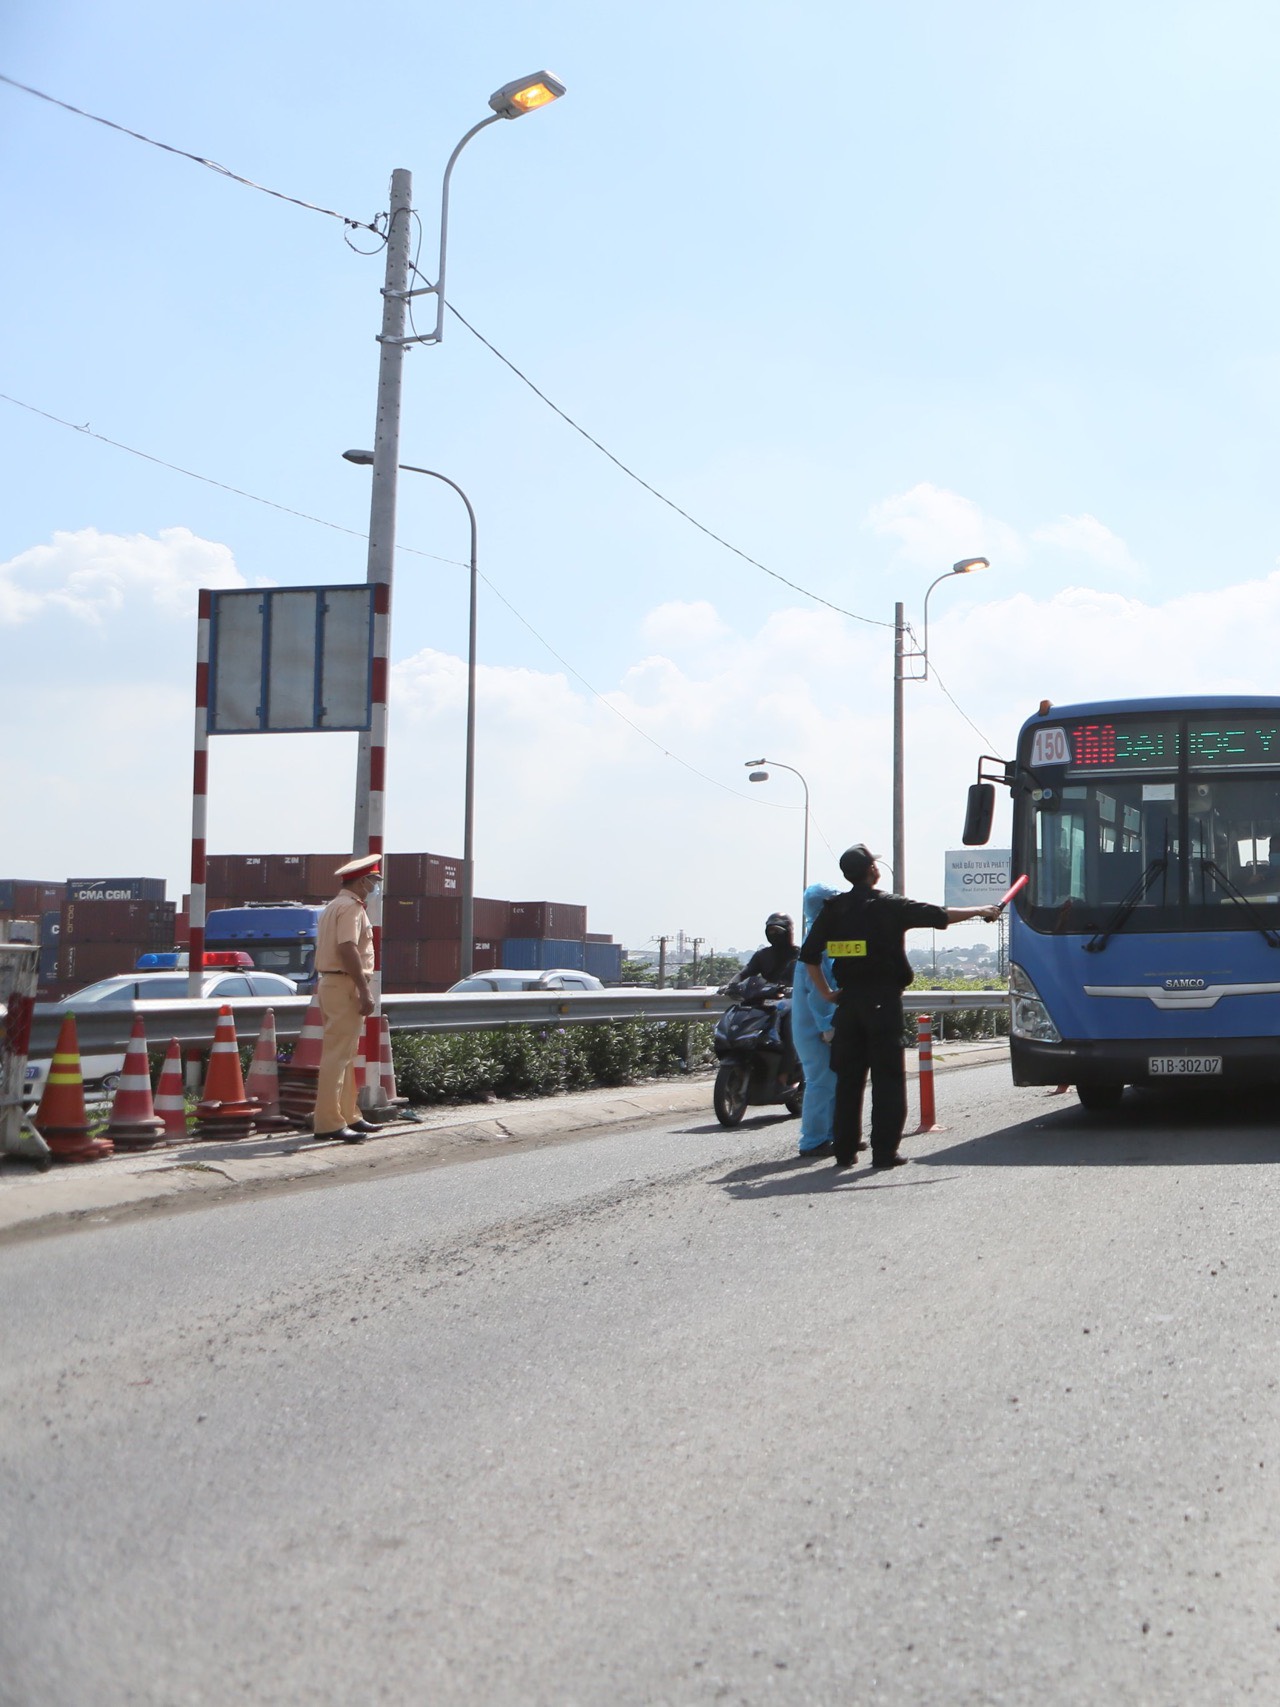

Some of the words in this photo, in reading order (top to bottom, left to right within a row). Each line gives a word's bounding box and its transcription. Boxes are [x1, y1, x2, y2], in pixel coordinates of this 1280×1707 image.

[1035, 731, 1065, 762] 150
[962, 873, 1007, 885] GOTEC
[79, 890, 104, 900] CMA
[105, 890, 131, 900] CGM
[1165, 979, 1205, 988] SAMCO
[1151, 1059, 1219, 1073] 51B-302.07
